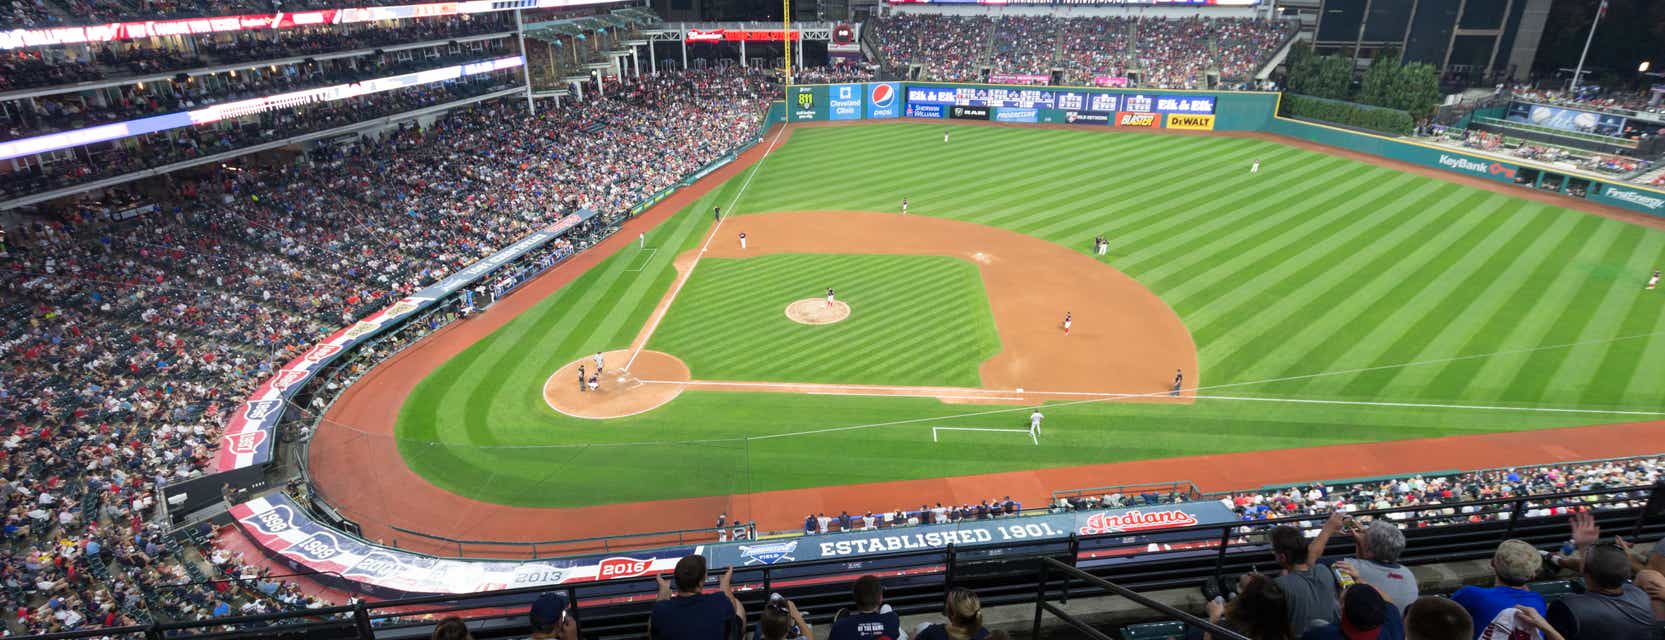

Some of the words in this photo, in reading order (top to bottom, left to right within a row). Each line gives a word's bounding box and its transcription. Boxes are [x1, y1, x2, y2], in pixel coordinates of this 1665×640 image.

[687, 30, 723, 40] Budweiser
[798, 93, 813, 107] 811
[1158, 98, 1178, 111] Elk
[1191, 101, 1212, 113] Elk
[873, 109, 893, 117] pepsi
[1439, 155, 1487, 173] KeyBank
[1605, 187, 1664, 208] FirstEnergy
[258, 510, 288, 533] 1998
[1080, 510, 1198, 536] Indians
[299, 536, 338, 560] 1999
[819, 528, 992, 557] ESTABLISHED
[997, 523, 1064, 541] 1901.
[602, 562, 645, 576] 2016
[514, 571, 562, 584] 2013
